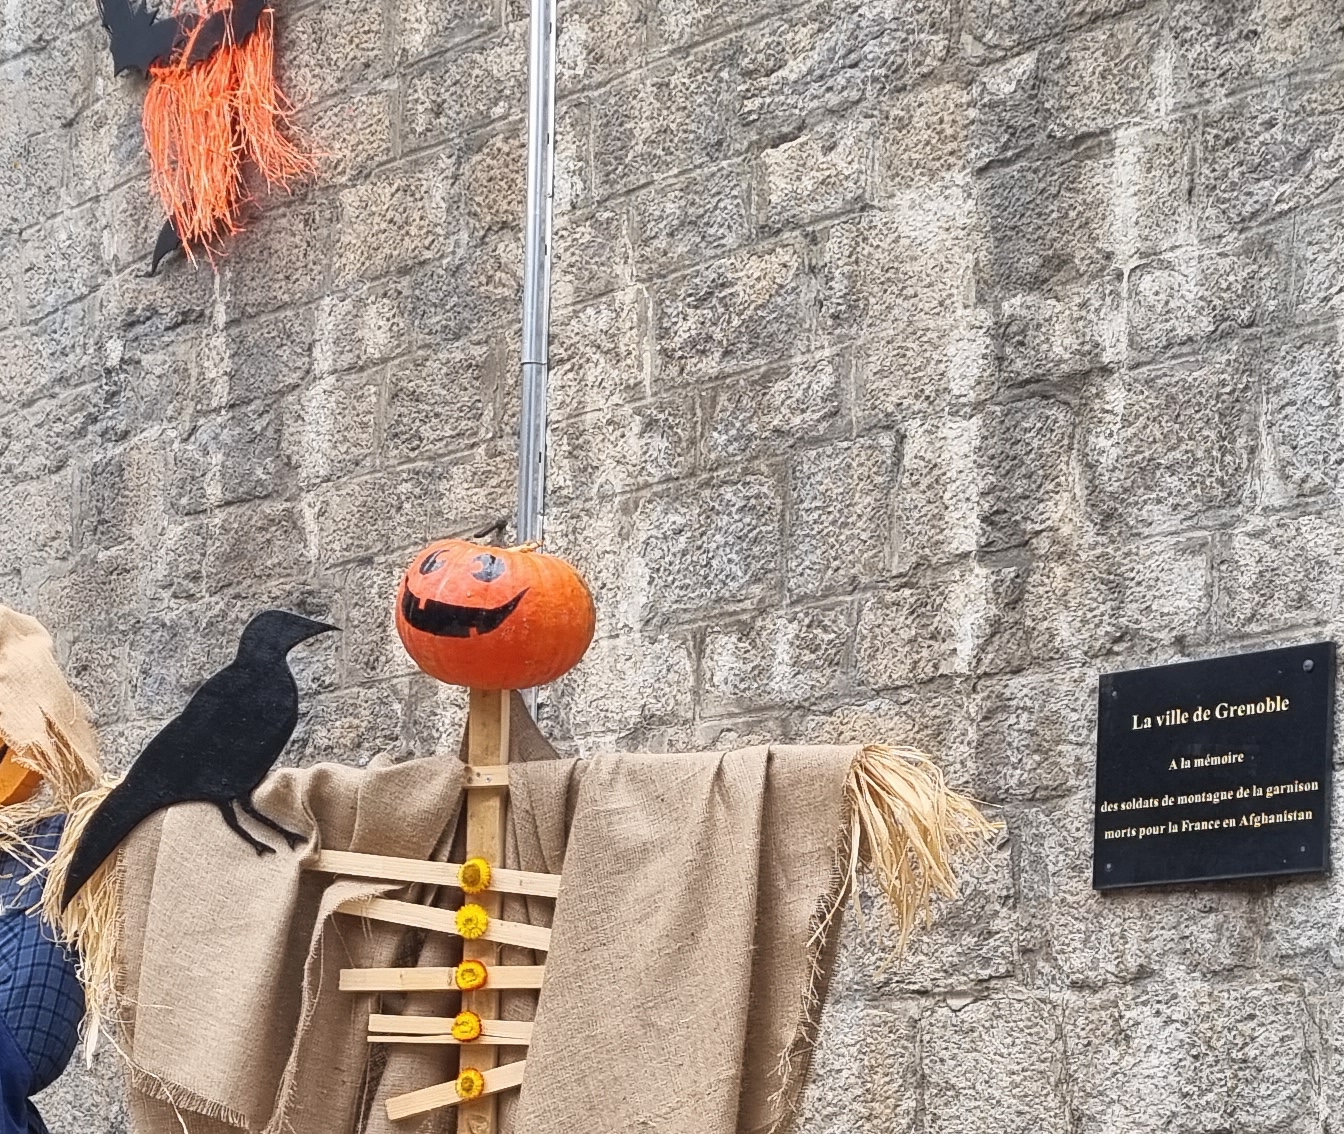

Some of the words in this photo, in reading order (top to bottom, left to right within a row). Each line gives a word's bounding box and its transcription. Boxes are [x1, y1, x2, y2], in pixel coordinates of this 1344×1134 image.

[1132, 714, 1152, 730] La
[1157, 709, 1189, 727] ville
[1193, 707, 1211, 722] de
[1215, 696, 1290, 719] Grenoble
[1169, 759, 1178, 770] A
[1181, 756, 1191, 768] la
[1194, 752, 1244, 767] mémoire
[1101, 801, 1118, 812] des
[1121, 797, 1159, 810] soldats
[1162, 795, 1175, 806] de
[1177, 789, 1234, 805] montagne
[1237, 786, 1250, 798] de
[1253, 785, 1263, 797] la
[1266, 780, 1319, 798] garnison
[1104, 827, 1136, 840] morts
[1139, 824, 1166, 839] pour
[1168, 821, 1178, 833] la
[1182, 818, 1220, 832] France
[1223, 818, 1236, 827] en
[1239, 809, 1313, 828] Afghanistan
